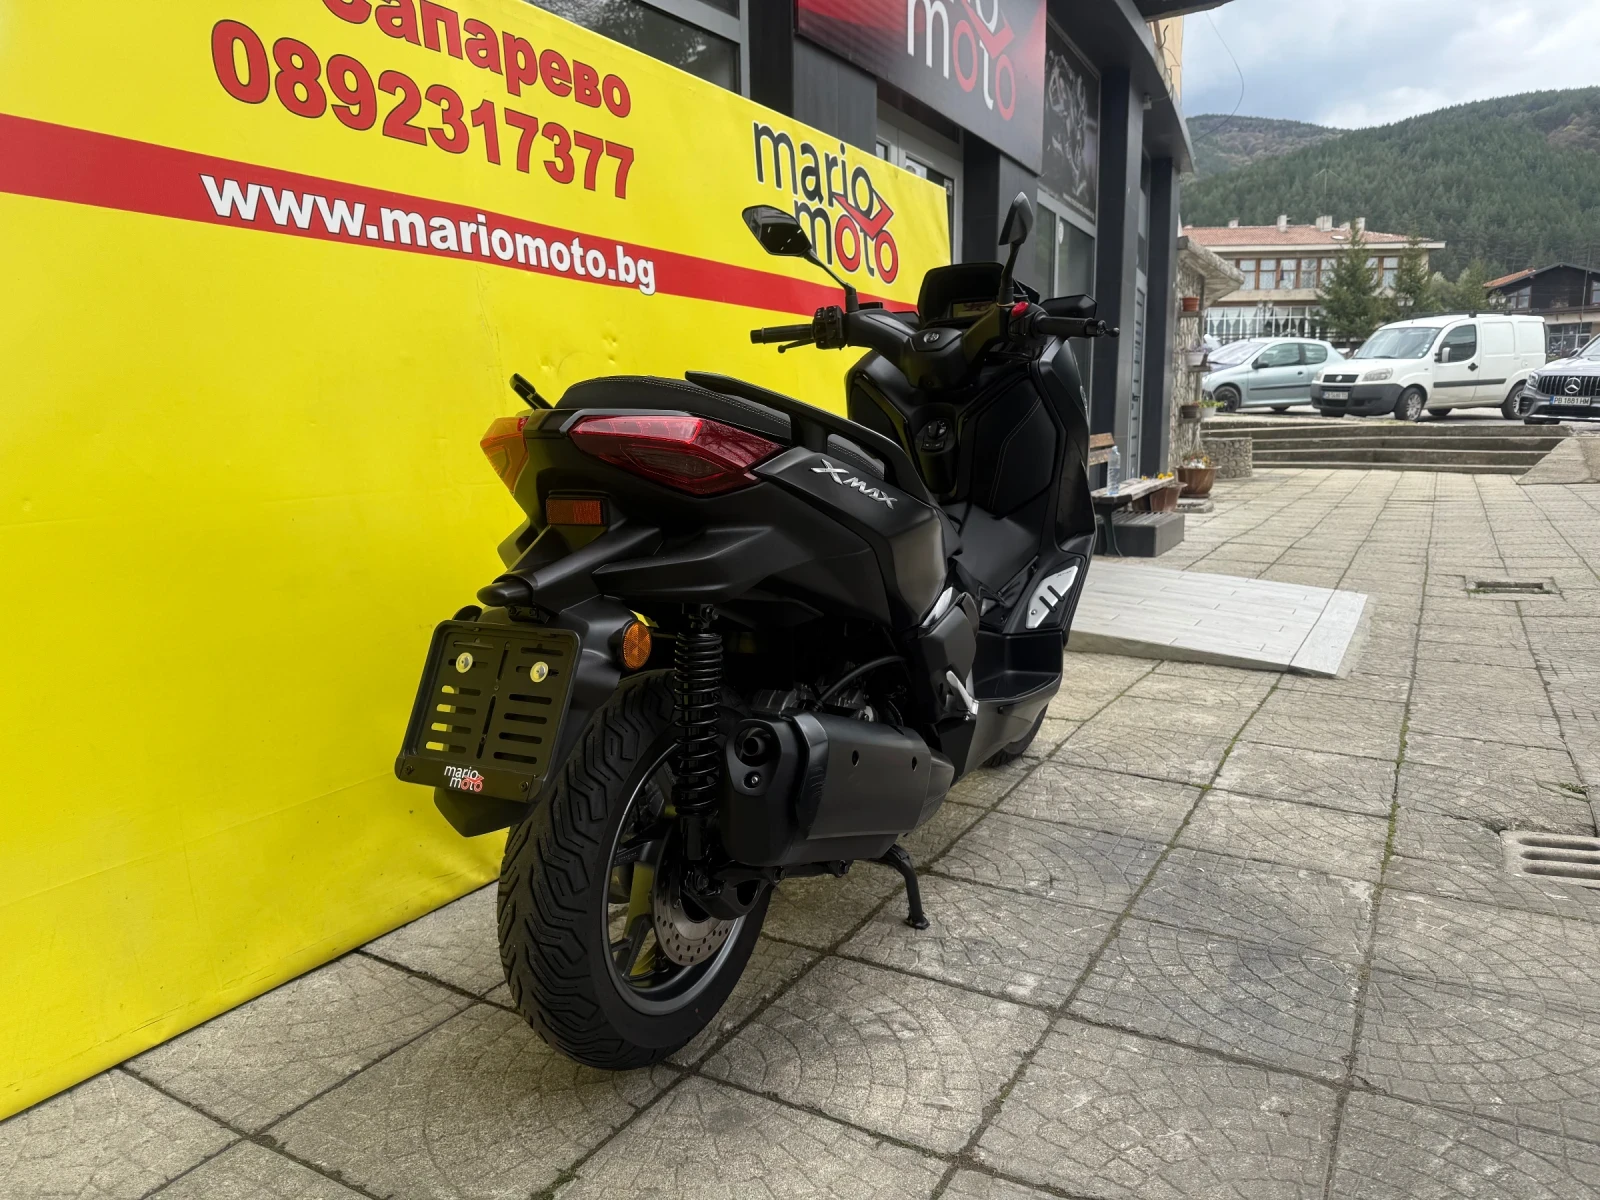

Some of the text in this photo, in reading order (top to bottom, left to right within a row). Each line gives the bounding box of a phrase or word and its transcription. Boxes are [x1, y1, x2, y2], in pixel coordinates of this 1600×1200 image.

[211, 19, 635, 200] 0892317377
[753, 122, 874, 219] mario
[199, 173, 656, 296] www.mariomoto.bg
[794, 199, 898, 284] moto
[443, 765, 479, 780] mario
[449, 777, 483, 793] moto
